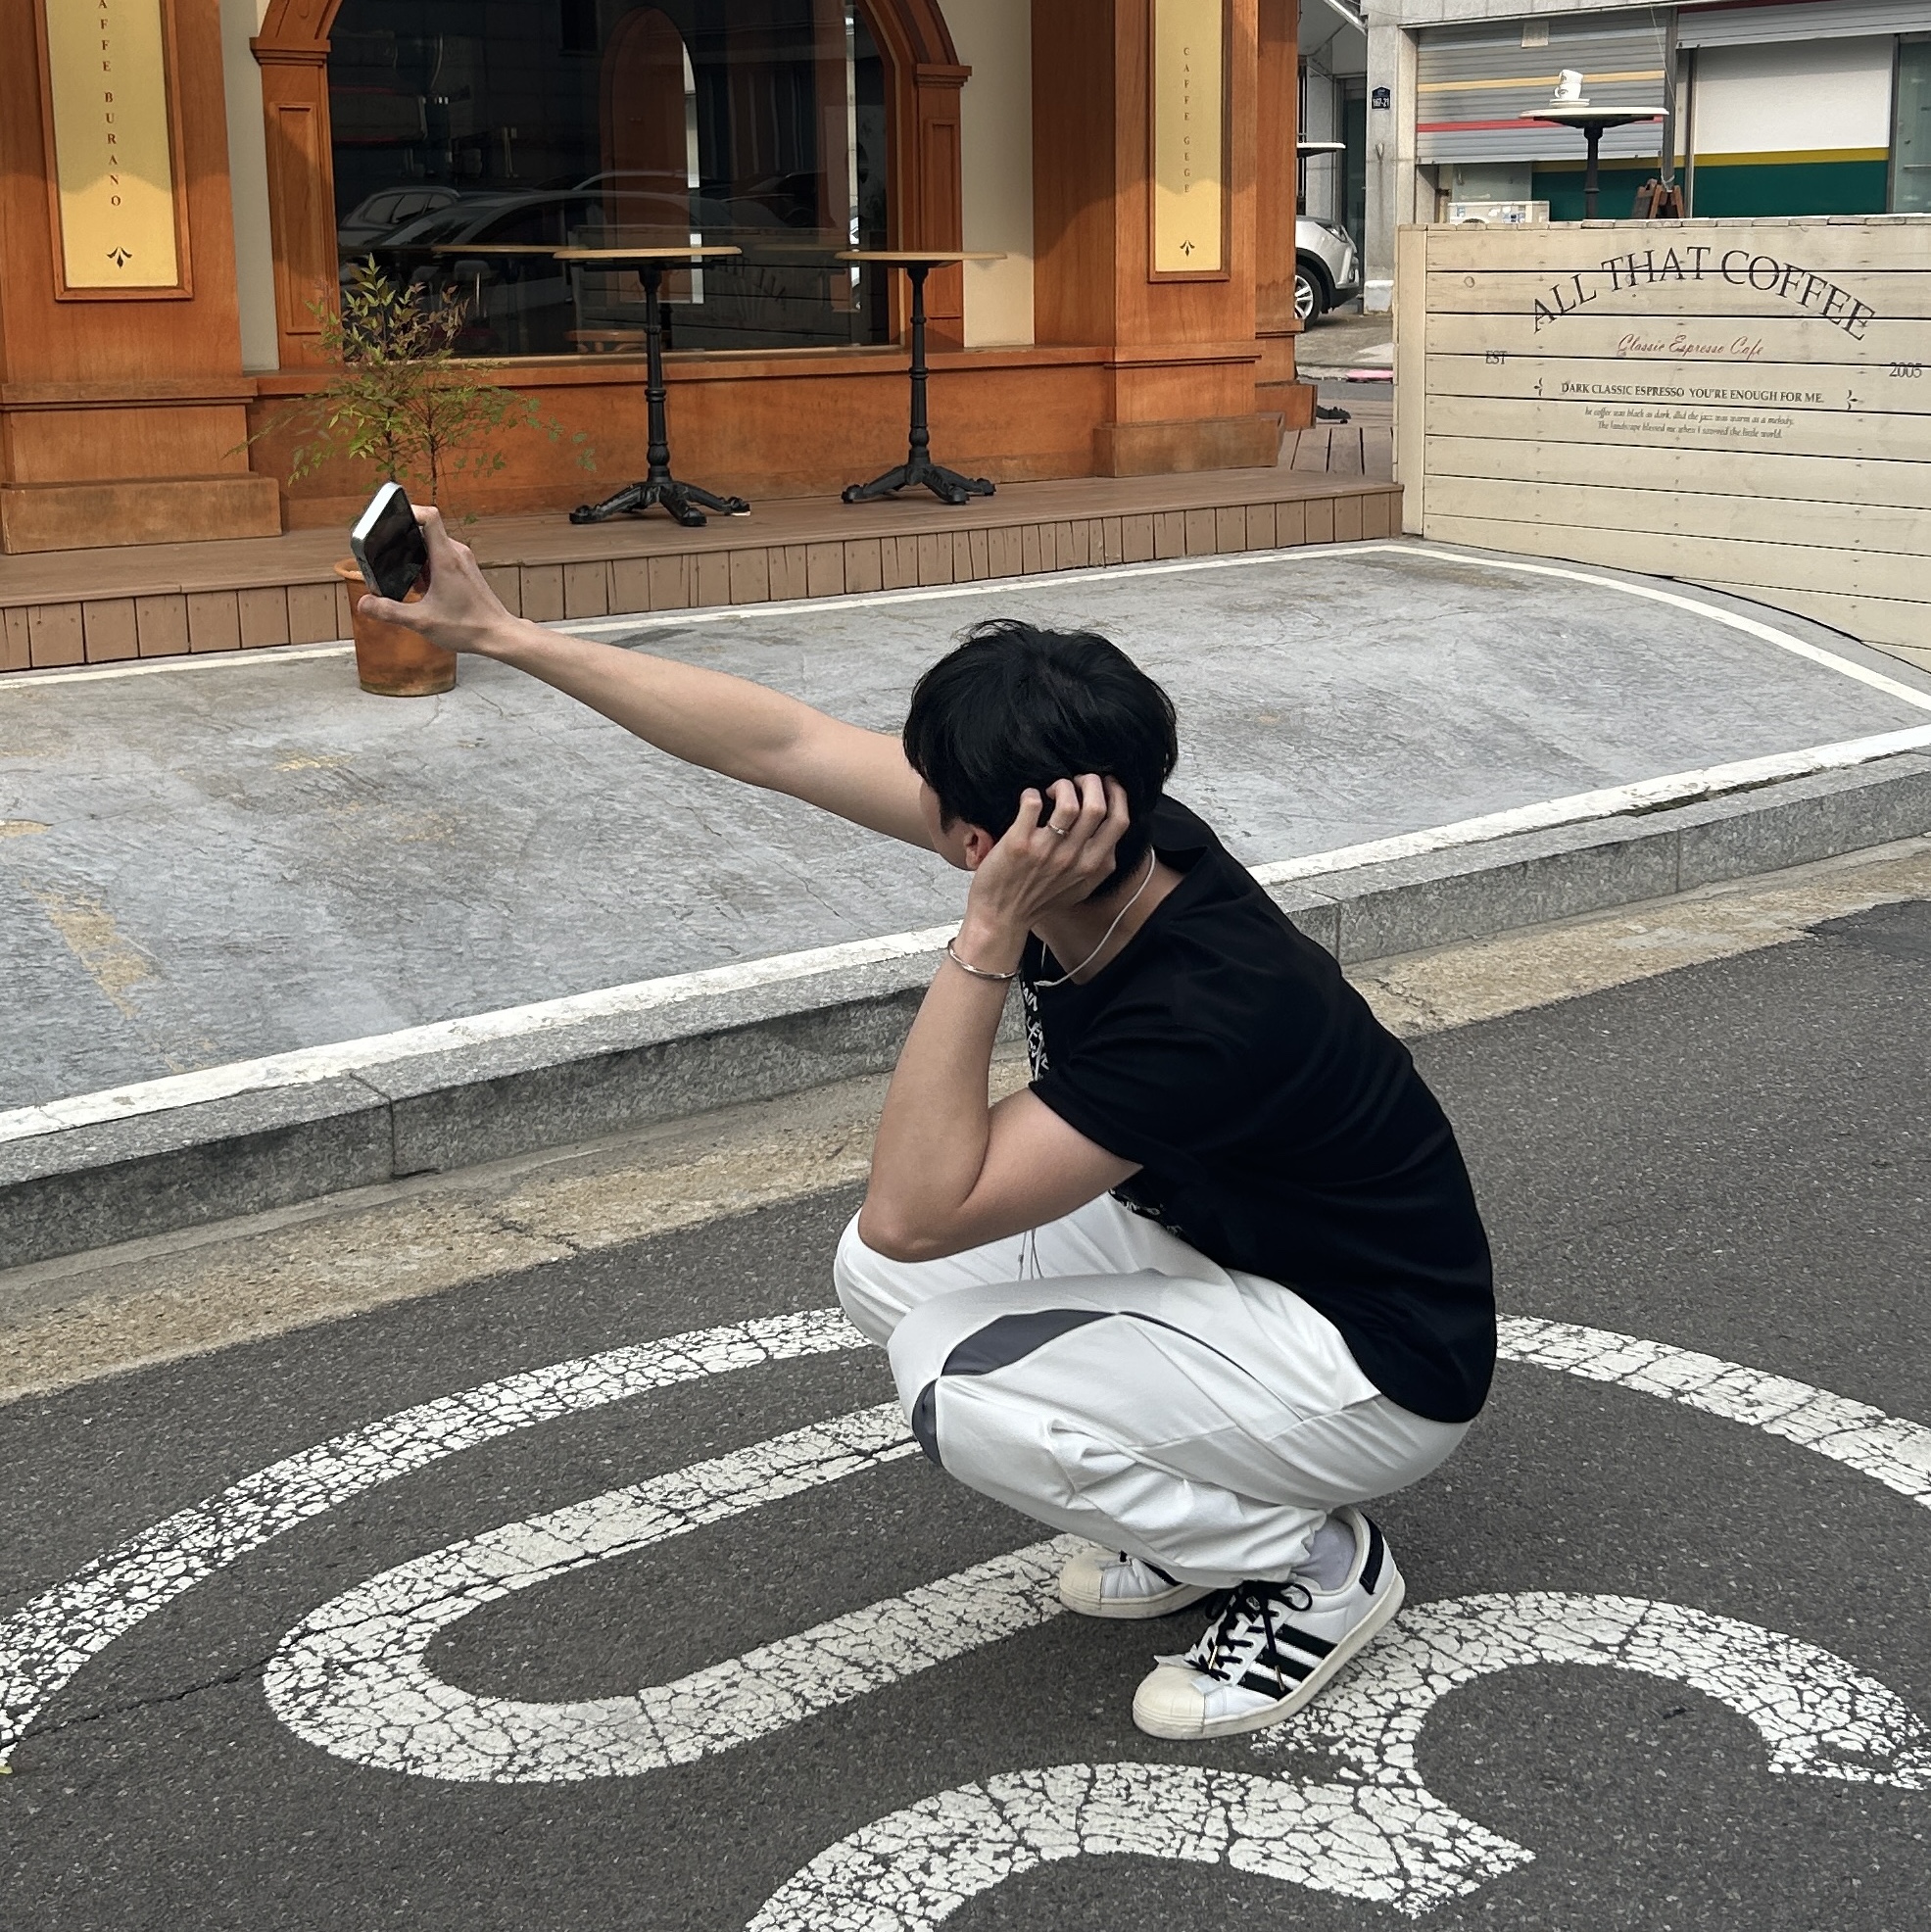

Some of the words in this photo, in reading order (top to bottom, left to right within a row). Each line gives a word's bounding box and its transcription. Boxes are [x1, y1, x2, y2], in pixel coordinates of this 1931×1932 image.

[105, 91, 121, 207] BURANO
[1533, 273, 1597, 334] ALL
[1600, 246, 1712, 292] THAT
[1720, 250, 1875, 341] COFFEE
[1617, 334, 1665, 355] Classic
[1668, 334, 1724, 357] Espresso
[1730, 336, 1764, 360] Cafe
[1485, 350, 1507, 364] EST
[1889, 362, 1922, 378] 2005
[1562, 383, 1589, 394] DARK
[1592, 385, 1632, 395] CLASSIC
[1635, 386, 1684, 397] ESPRESSO
[1689, 388, 1727, 399] YOU'RE
[1730, 390, 1777, 402] ENOUGH
[1780, 392, 1803, 402] FOR
[1598, 419, 1609, 430] The
